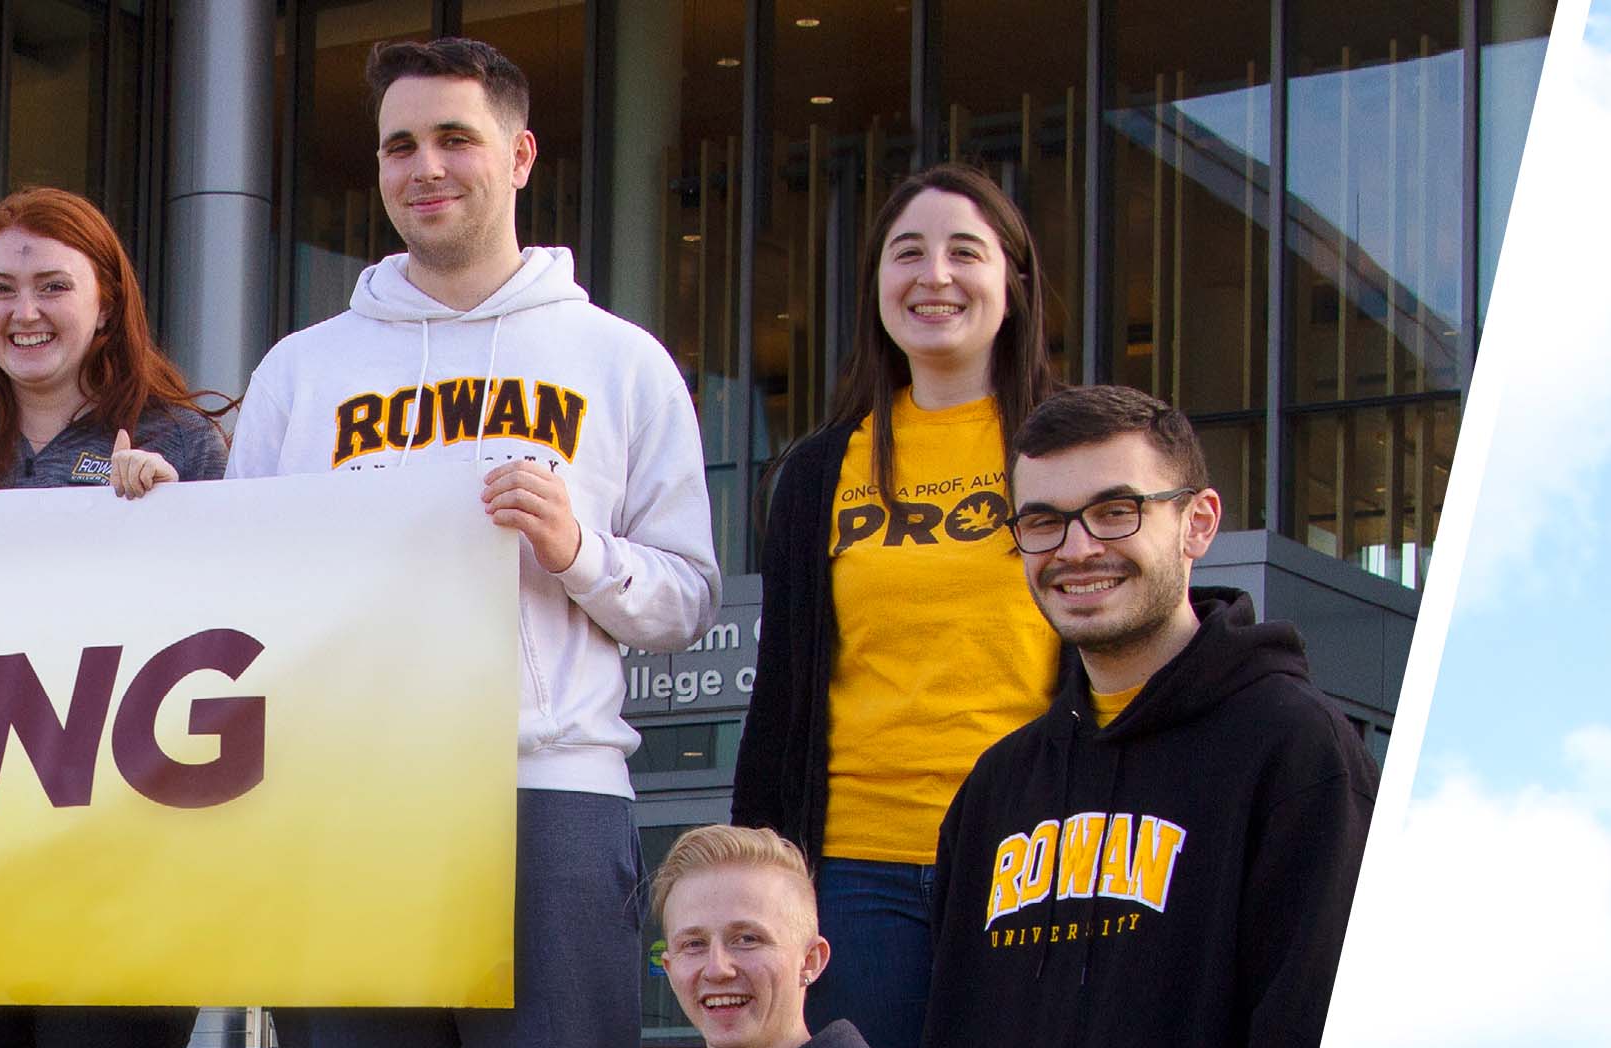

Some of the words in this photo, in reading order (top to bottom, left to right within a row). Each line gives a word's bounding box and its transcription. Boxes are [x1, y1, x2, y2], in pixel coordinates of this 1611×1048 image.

[332, 377, 587, 470] ROWAN
[842, 485, 879, 502] ONC
[915, 478, 965, 497] PROF,
[630, 666, 723, 703] llege
[984, 811, 1187, 932] ROWAN
[991, 913, 1141, 948] UNIVERITY
